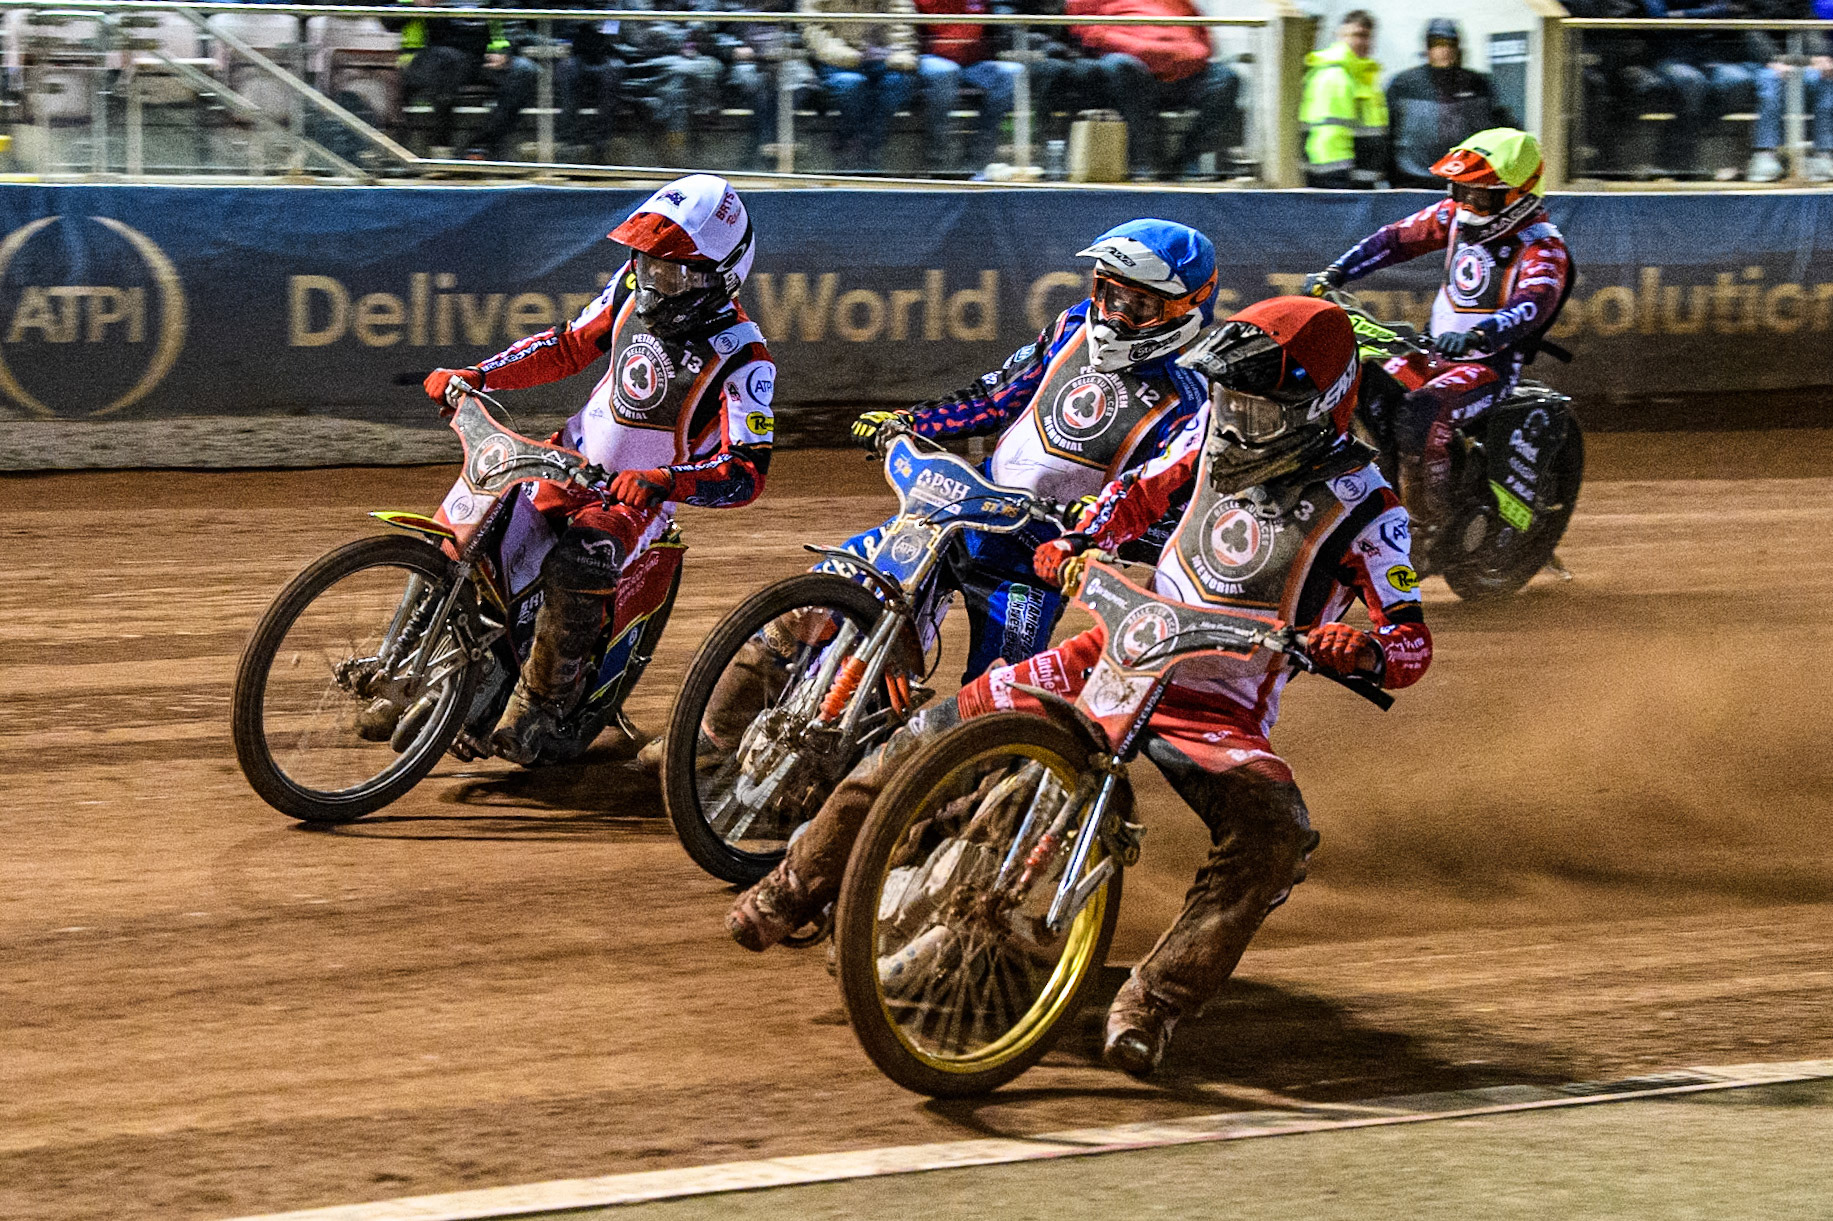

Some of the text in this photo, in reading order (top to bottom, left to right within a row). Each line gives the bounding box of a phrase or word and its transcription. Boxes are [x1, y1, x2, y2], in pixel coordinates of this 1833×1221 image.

[7, 284, 148, 344] ATPI
[286, 271, 614, 347] Deliver
[754, 269, 999, 342] World
[631, 333, 676, 379] PETER CRAVEN
[679, 349, 704, 375] 13
[1071, 377, 1115, 417] BELLE VUE ACES
[1134, 381, 1161, 408] 12
[1043, 415, 1084, 452] MEMORIAL
[1213, 500, 1241, 518] BELLE
[1259, 520, 1270, 546] ACES
[1192, 554, 1246, 595] MEMORIAL
